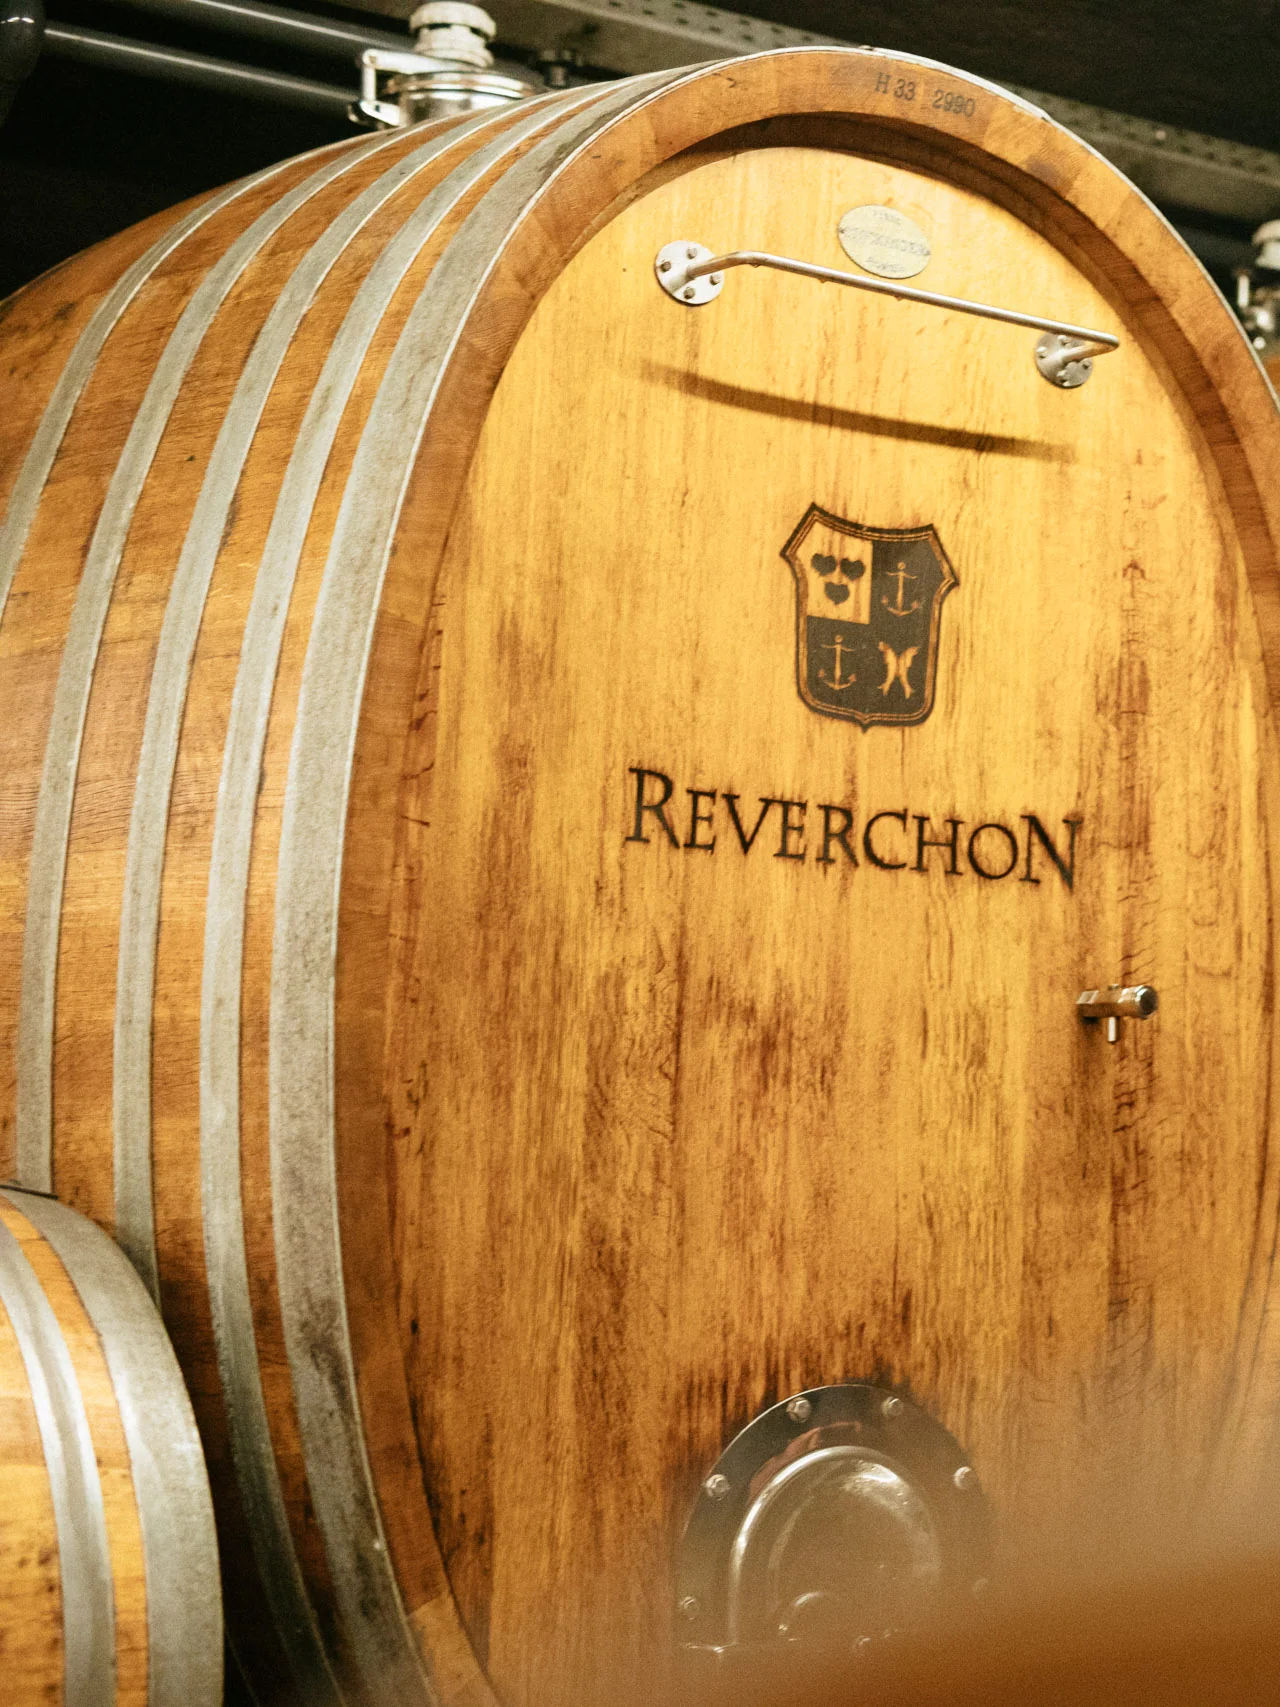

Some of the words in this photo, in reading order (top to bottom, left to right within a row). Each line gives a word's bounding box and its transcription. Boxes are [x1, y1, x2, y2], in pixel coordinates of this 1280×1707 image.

[875, 72, 890, 94] H
[894, 79, 916, 101] 33
[625, 767, 1082, 890] REVERCHON
